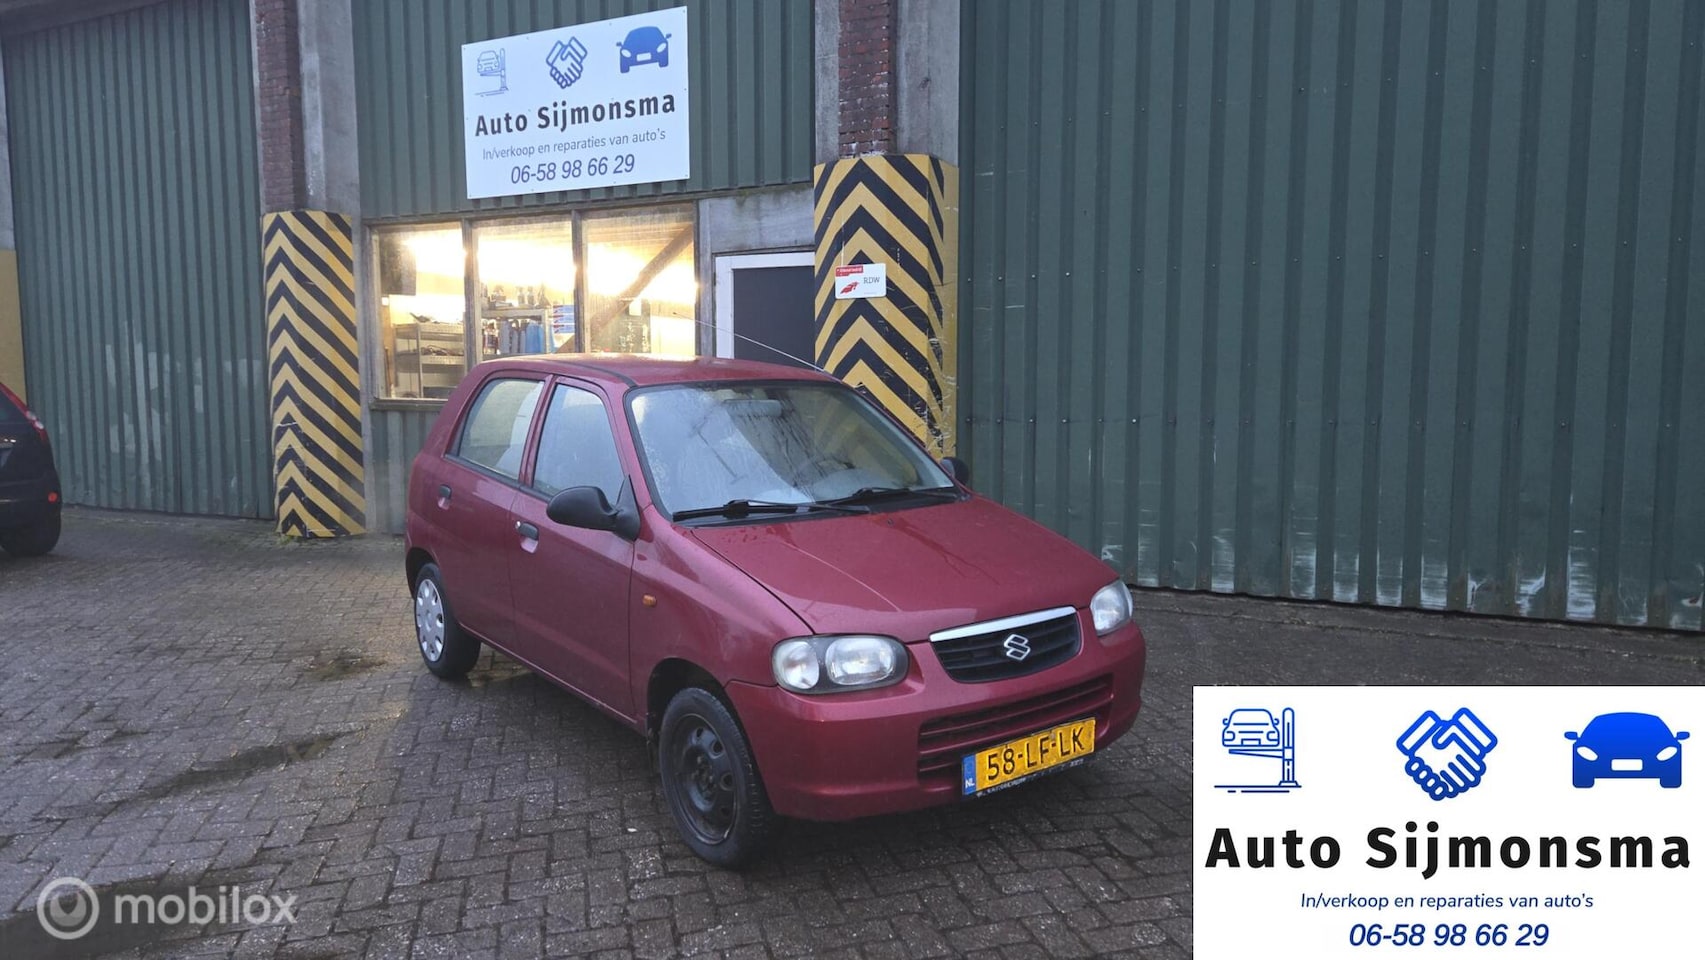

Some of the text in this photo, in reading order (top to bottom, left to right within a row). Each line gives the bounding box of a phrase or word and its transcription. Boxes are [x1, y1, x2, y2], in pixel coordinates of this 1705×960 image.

[475, 94, 675, 136] Auto Sijmonsma
[482, 128, 666, 160] In/verkoop en reparaties van auto's
[511, 154, 635, 184] 06-58 98 66 29
[987, 727, 1085, 780] 58-LF-LK
[965, 778, 975, 788] NL
